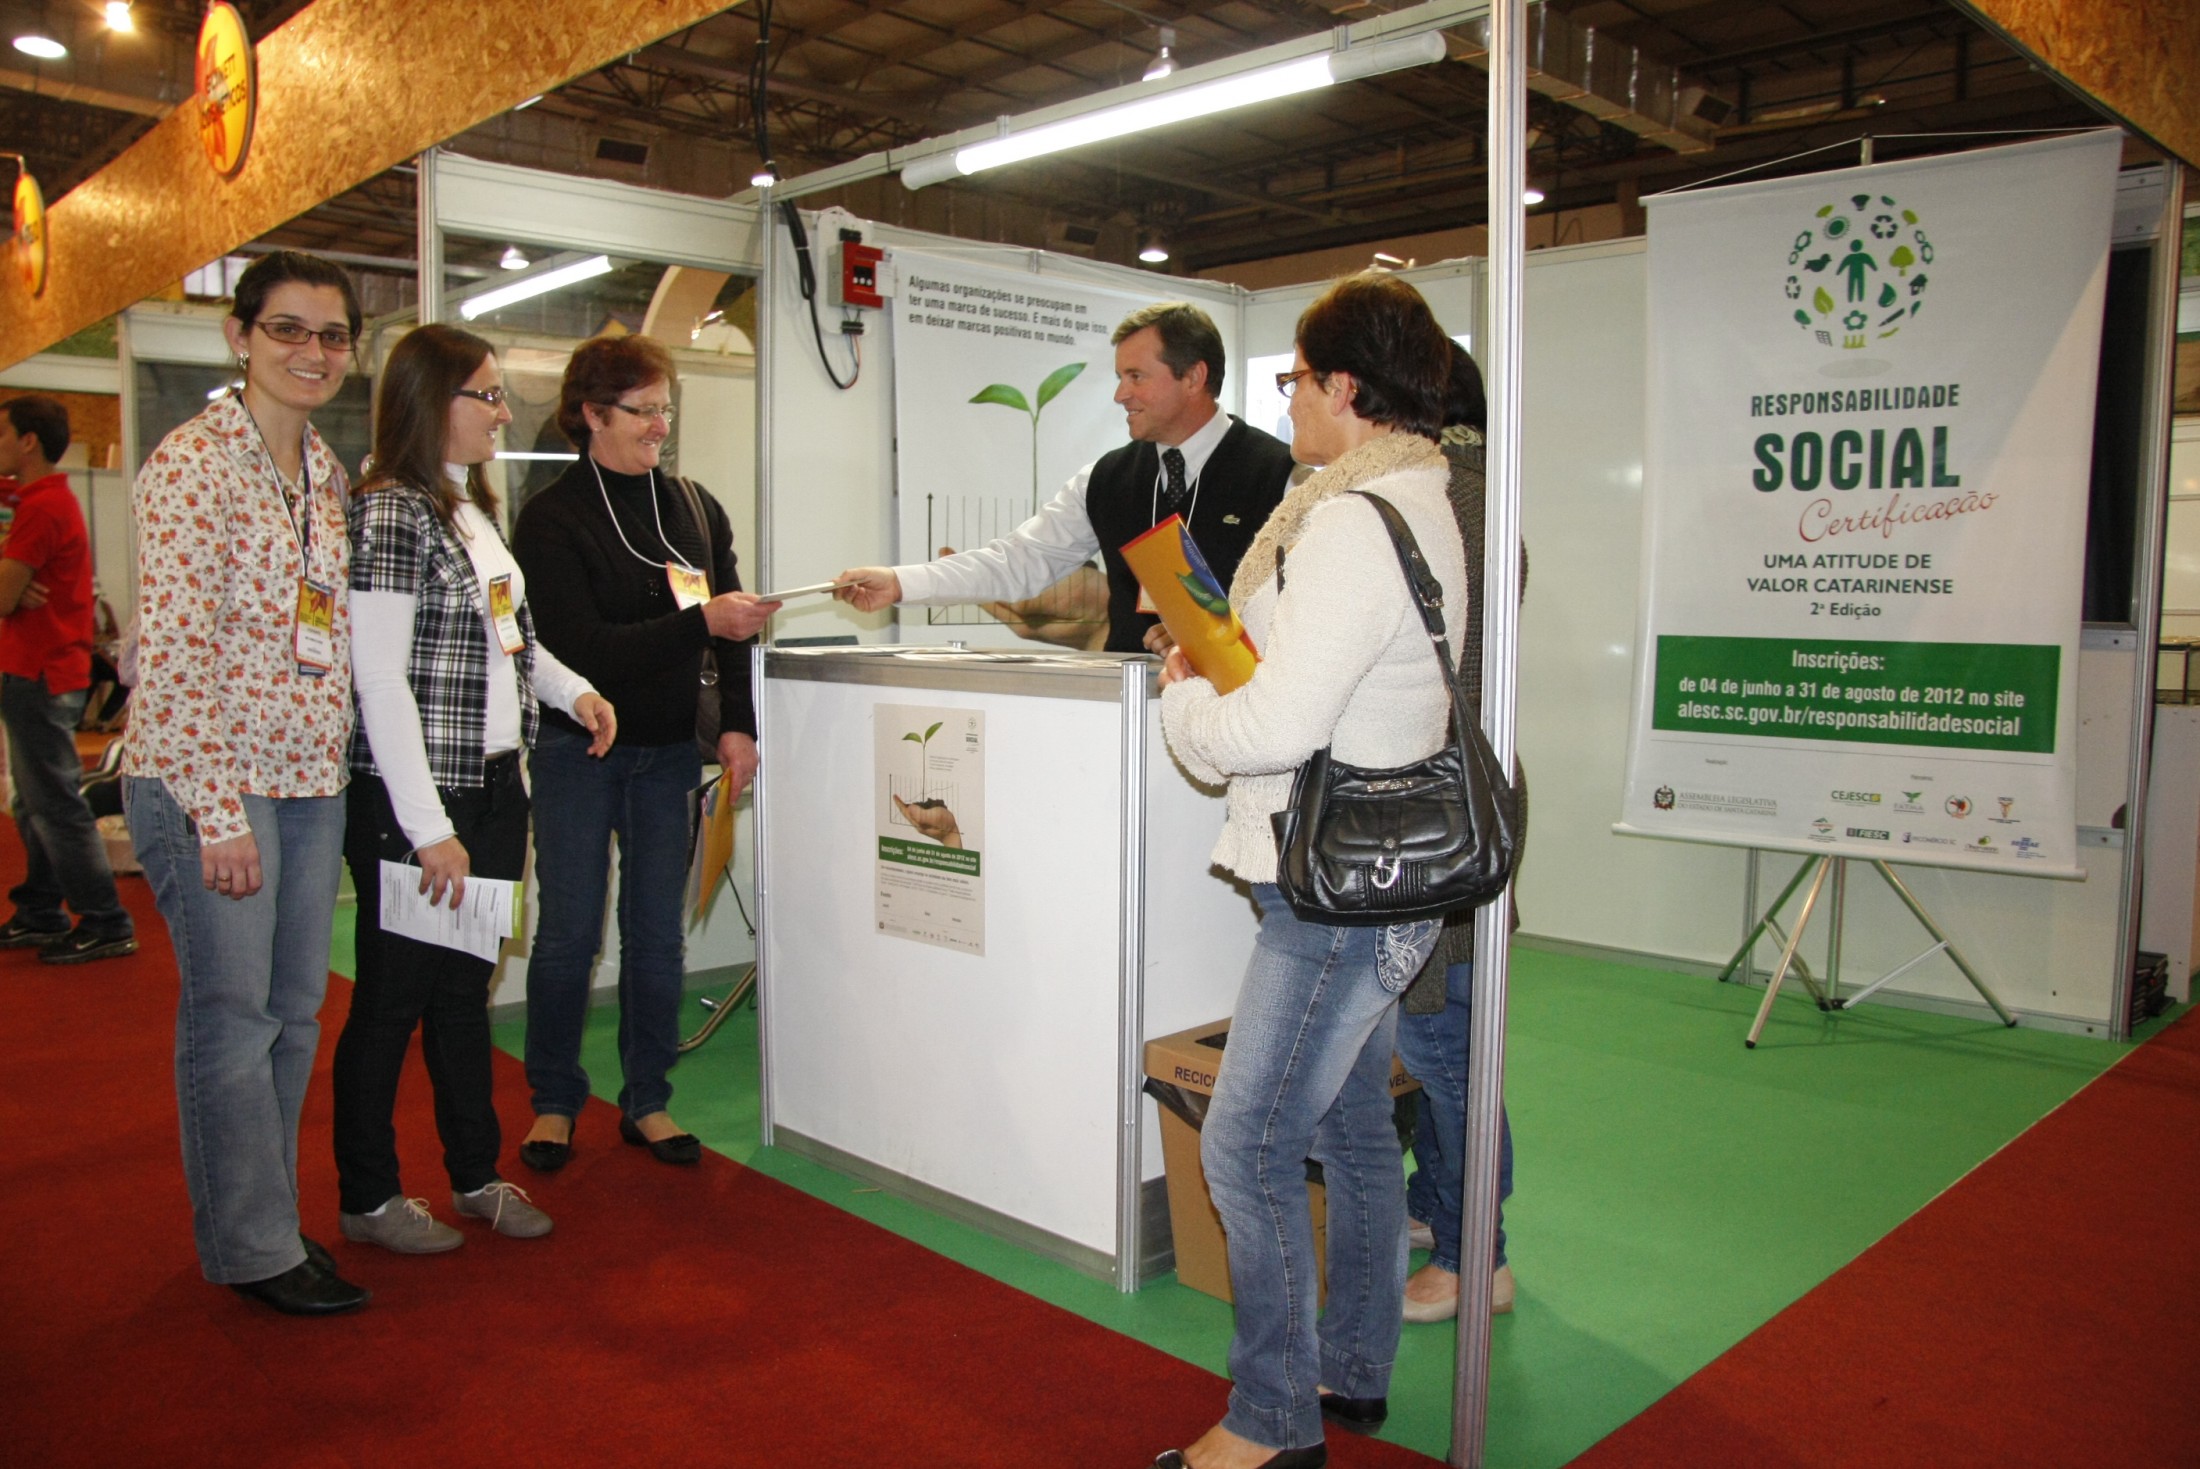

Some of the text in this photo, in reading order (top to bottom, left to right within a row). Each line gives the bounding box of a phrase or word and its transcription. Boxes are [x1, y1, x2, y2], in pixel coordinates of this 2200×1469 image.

[909, 275, 951, 292] Algumas
[953, 284, 1012, 303] organizações
[1014, 294, 1024, 304] se
[1027, 296, 1073, 312] preocupam
[1074, 304, 1087, 314] em
[909, 294, 921, 306] ter
[924, 298, 945, 310] uma
[947, 301, 977, 314] marca
[979, 304, 990, 317] de
[1040, 314, 1061, 327] mais
[1062, 316, 1074, 329] do
[1075, 321, 1090, 334] que
[909, 313, 924, 324] em
[926, 314, 955, 328] deixar
[957, 320, 991, 334] marcas
[993, 325, 1032, 340] positivas
[1034, 331, 1045, 342] no
[1751, 384, 1960, 417] RESPONSABILIDADE
[1753, 426, 1960, 493] SOCIAL
[1799, 491, 1999, 543] Certificação
[1764, 554, 1932, 569] UMA ATITUDE DE
[1747, 578, 1954, 594] VALOR CATARINENSE
[1830, 602, 1881, 620] Edição
[1792, 650, 1885, 674] Inscrições:
[1679, 677, 2025, 707] de 04 de junho a 31 de agosto de 2012 no site
[1678, 700, 2022, 736] alesc.sc.gov.br/responsabilidadesocial
